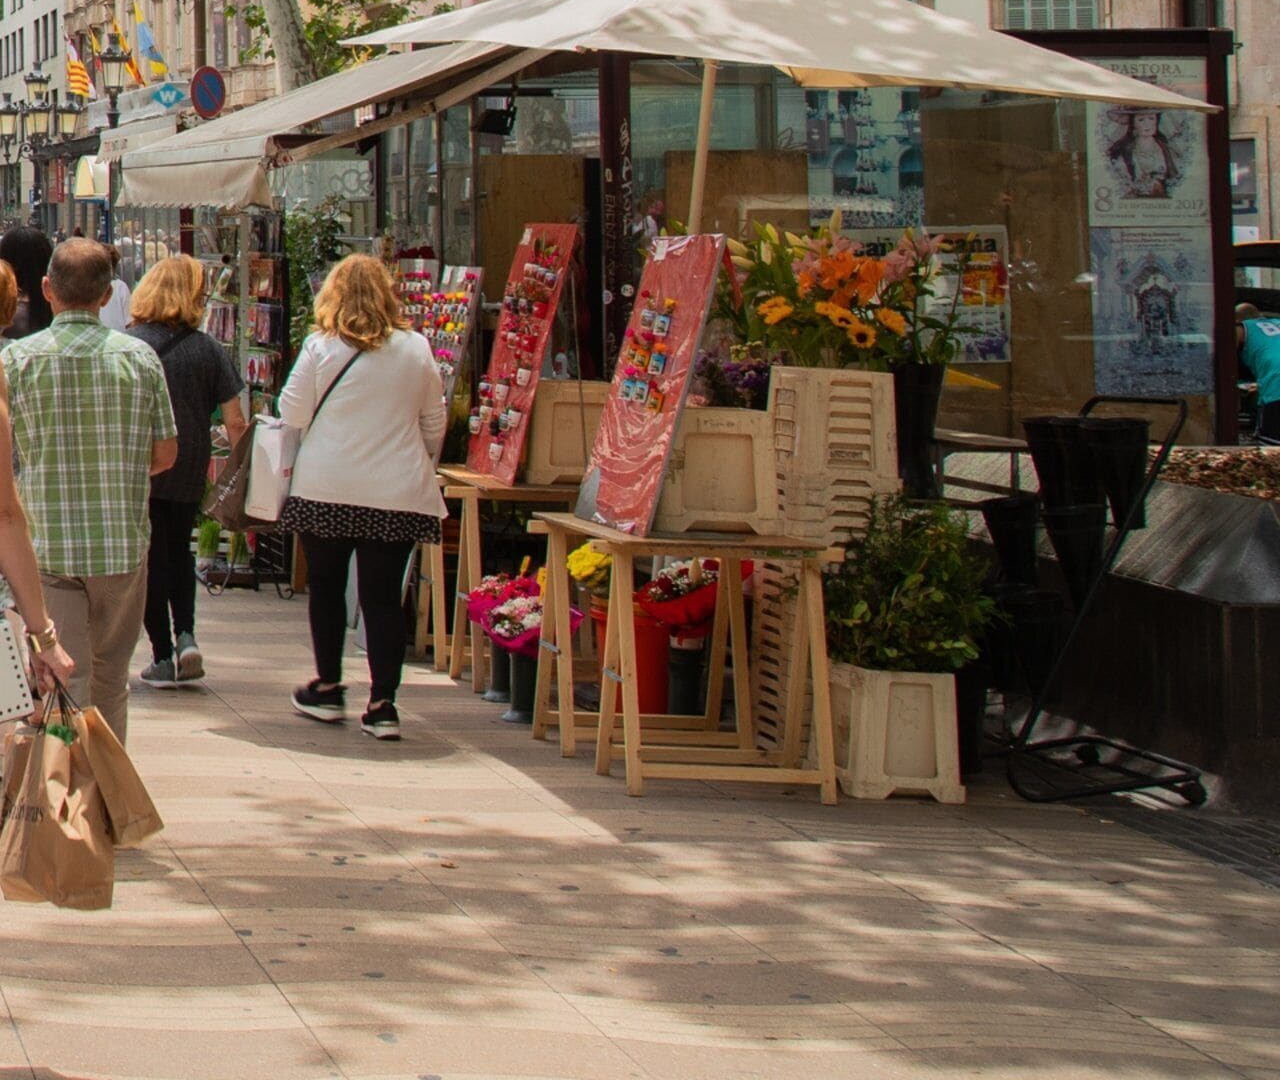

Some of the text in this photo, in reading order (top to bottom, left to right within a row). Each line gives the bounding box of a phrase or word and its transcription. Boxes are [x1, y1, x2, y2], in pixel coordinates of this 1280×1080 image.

[1110, 63, 1182, 75] PASTORA
[1094, 185, 1113, 213] 8
[1175, 199, 1205, 210] 2017
